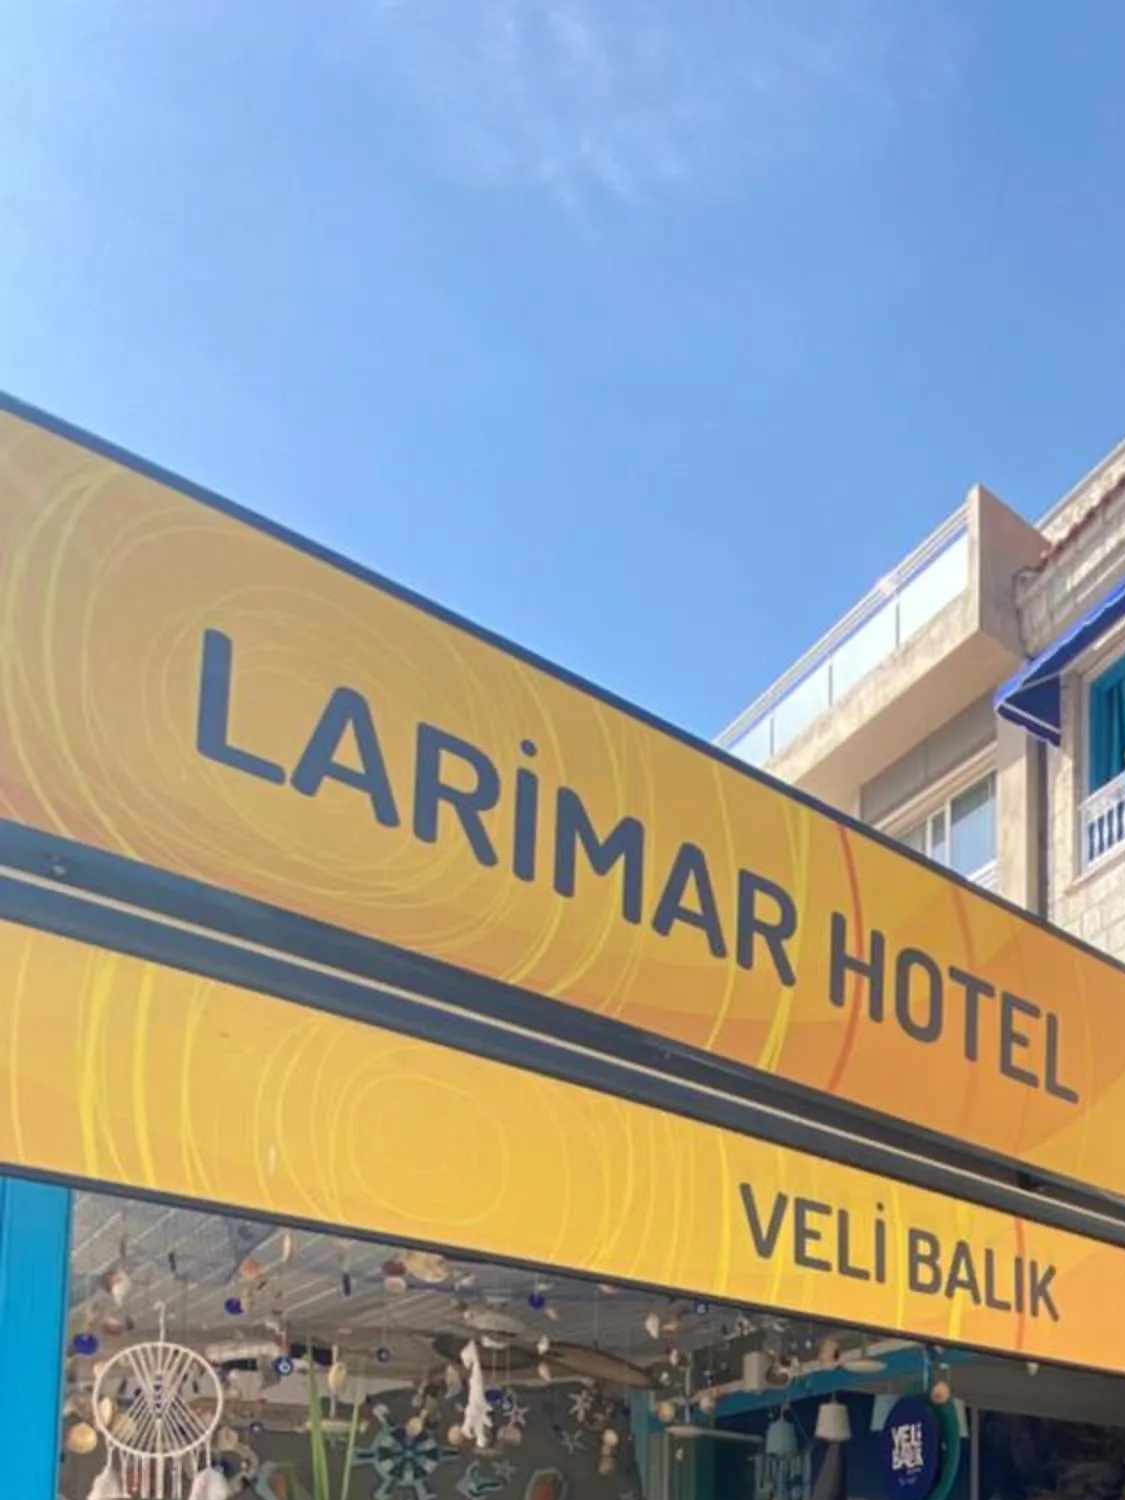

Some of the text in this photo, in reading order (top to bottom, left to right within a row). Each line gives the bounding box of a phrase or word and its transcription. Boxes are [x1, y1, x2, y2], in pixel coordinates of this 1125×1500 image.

[195, 627, 1081, 1106] LARİMAR HOTEL
[738, 1182, 1060, 1322] VELİ BALIK
